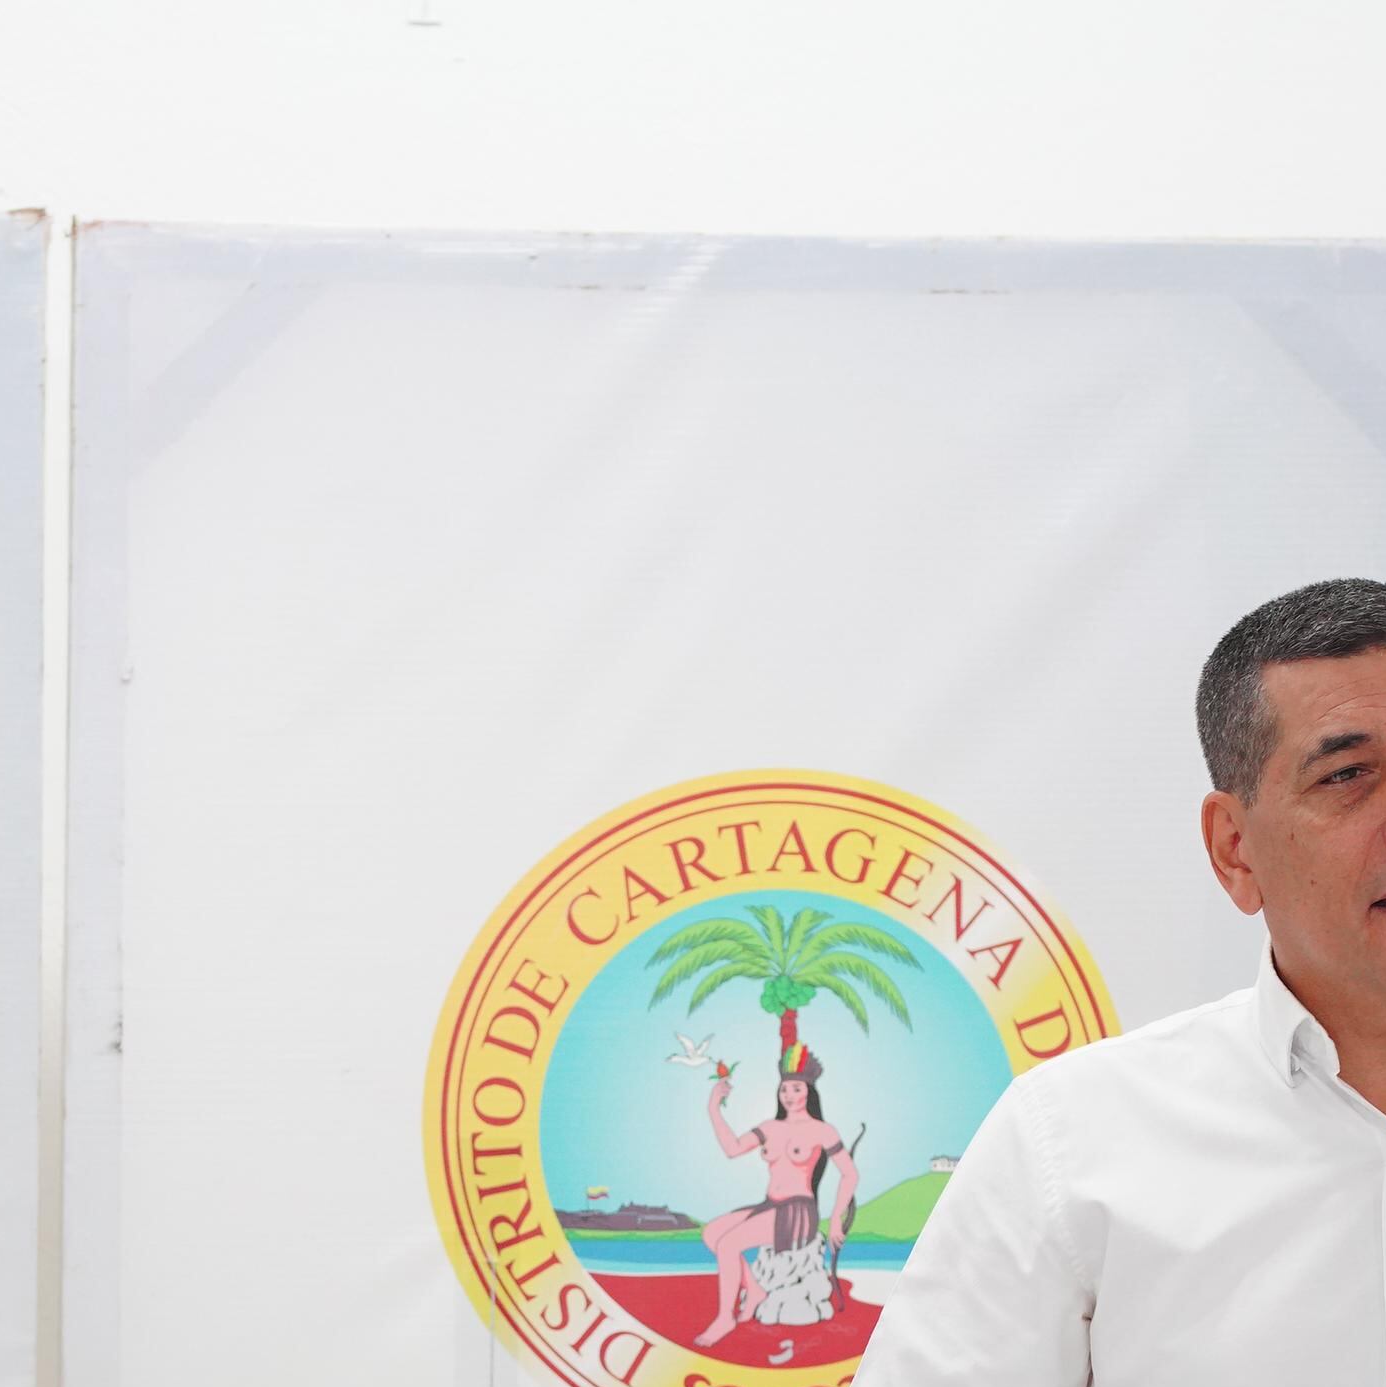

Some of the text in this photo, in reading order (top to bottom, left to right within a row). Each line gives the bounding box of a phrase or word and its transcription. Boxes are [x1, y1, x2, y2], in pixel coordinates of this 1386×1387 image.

[481, 957, 571, 1063] DE
[565, 818, 1026, 992] CARTAGENA
[1012, 999, 1072, 1060] D
